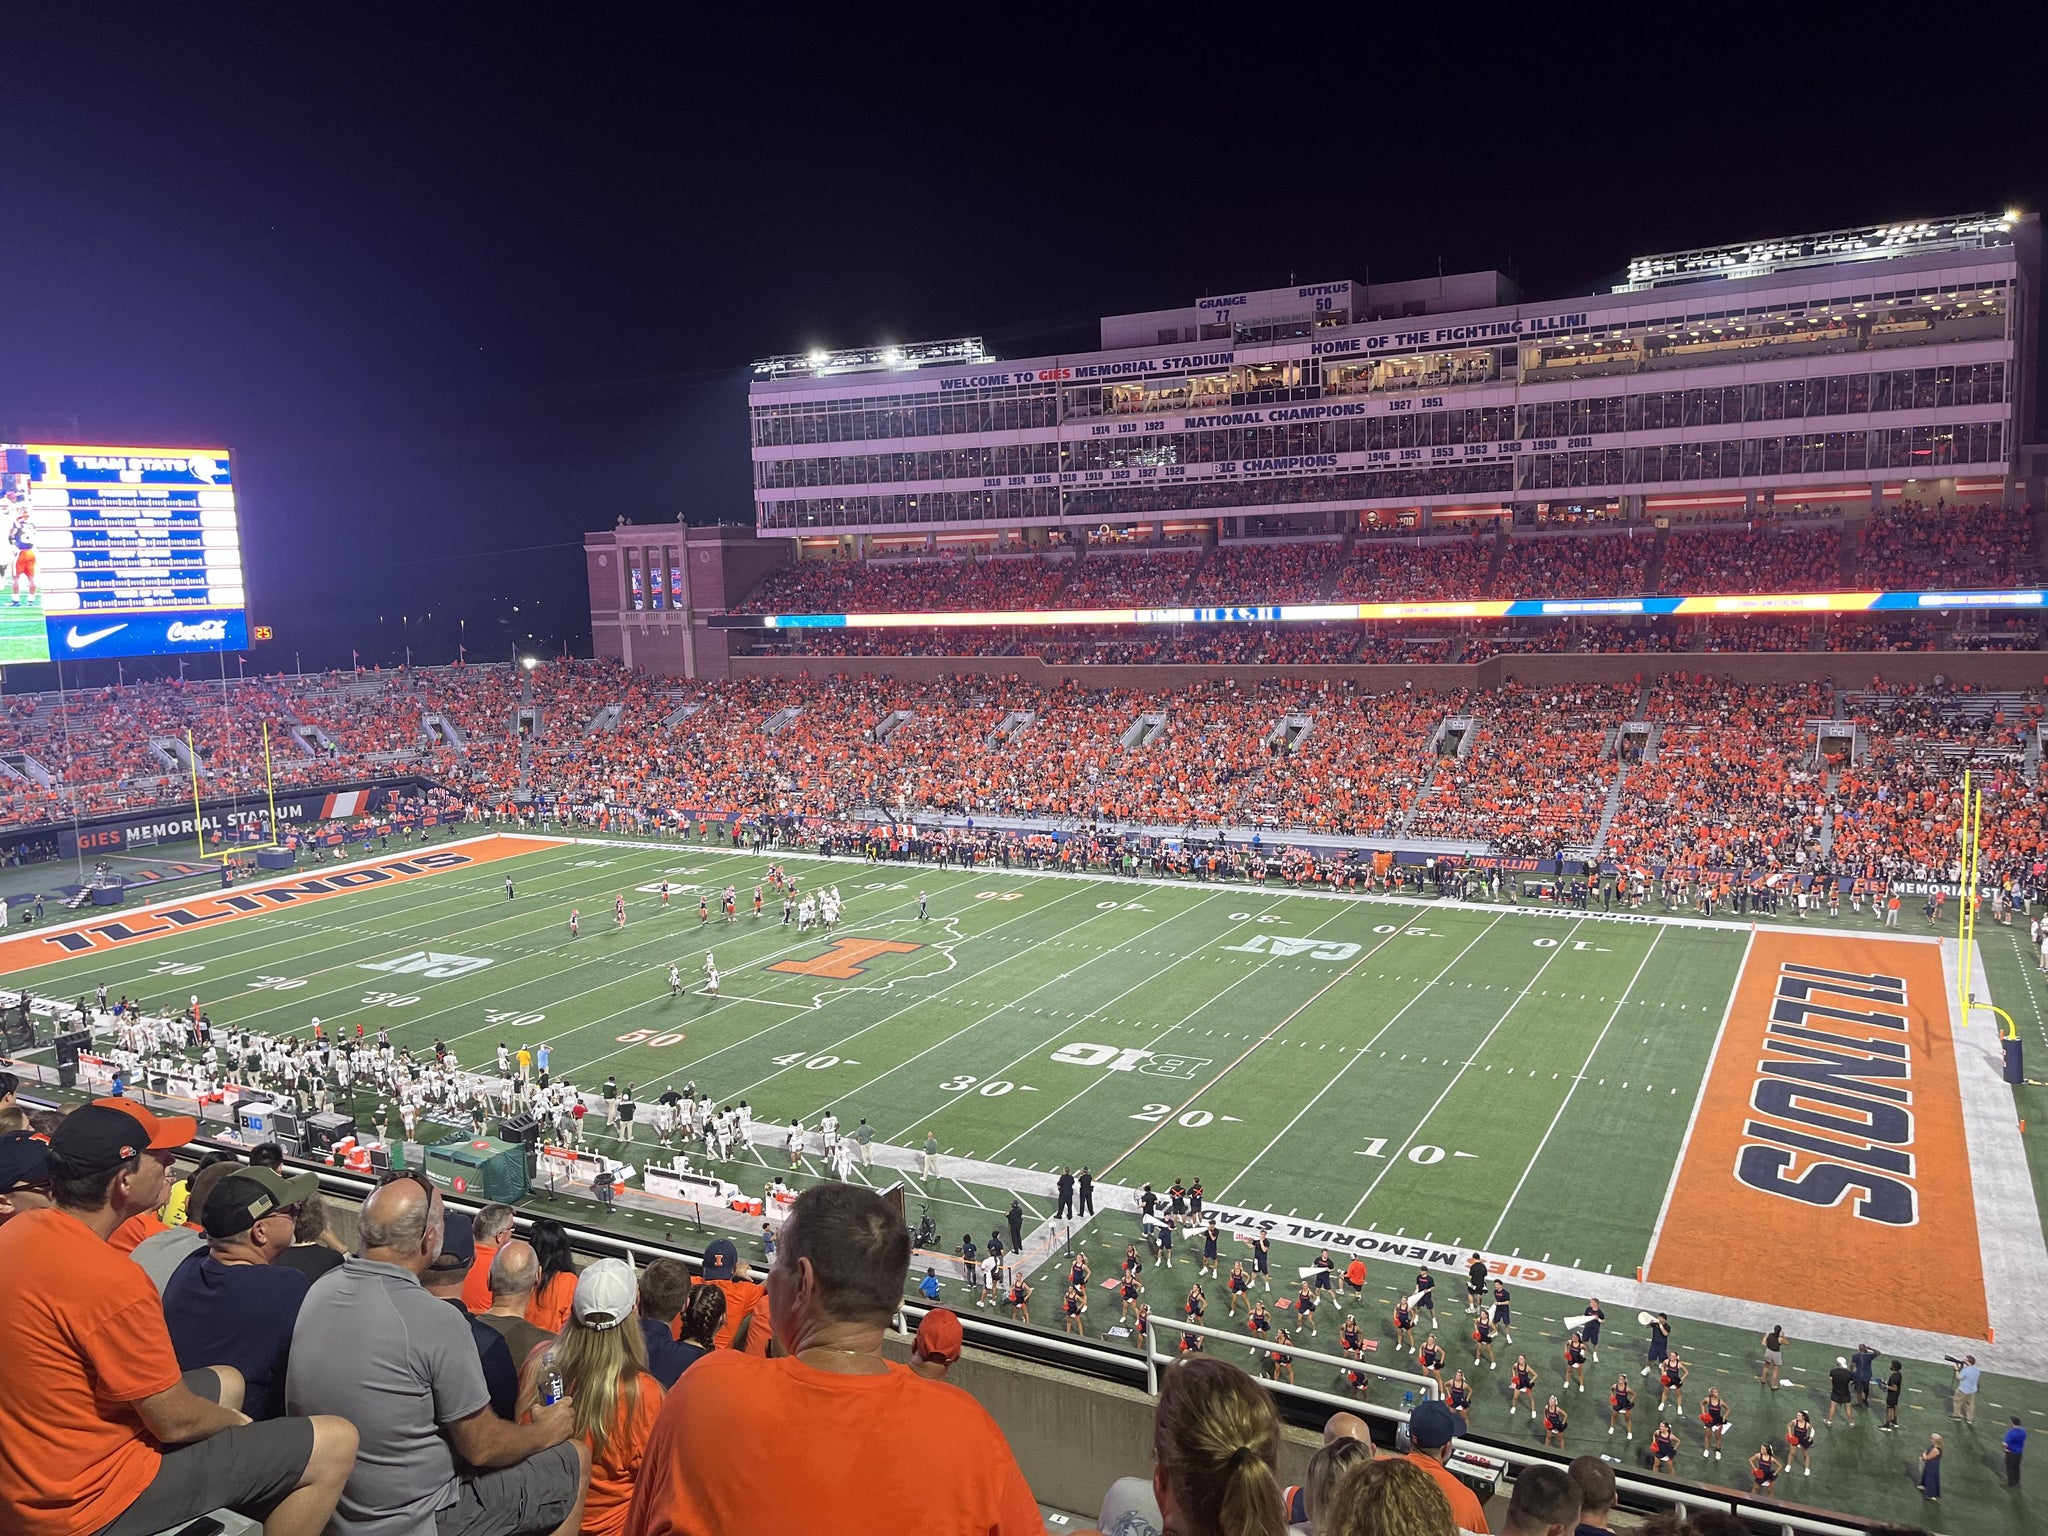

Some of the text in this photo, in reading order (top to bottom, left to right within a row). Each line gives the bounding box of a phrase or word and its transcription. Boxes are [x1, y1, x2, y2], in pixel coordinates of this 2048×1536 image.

[1298, 283, 1349, 298] BUTKUS
[1199, 296, 1247, 309] GRANGE
[1316, 298, 1332, 311] 50
[1216, 310, 1230, 322] 77
[1311, 313, 1587, 355] HOME OF THE FIGHTING ILLINI
[940, 353, 1234, 390] WELCOME TO GIES MEMORIAL STADIUM
[1091, 397, 1443, 436] 1914 1919 1923 NATIONAL CHAMPIONS 1927 1951
[73, 457, 187, 471] TEAM STATS
[1008, 476, 1026, 486] 1914
[1033, 475, 1051, 485] 1915
[1085, 471, 1104, 481] 1919
[1111, 469, 1130, 480] 1923
[1138, 467, 1157, 478] 1927
[1165, 466, 1185, 476] 1928
[1243, 454, 1337, 471] CHAMPIONS
[1367, 451, 1390, 462] 1946
[1399, 449, 1421, 460] 1951
[1431, 447, 1454, 458] 1953
[1464, 444, 1487, 455] 1963
[1497, 441, 1522, 453] 1983
[1532, 439, 1557, 451] 1990
[1568, 437, 1592, 448] 2001
[79, 804, 303, 849] GIES MEMORIAL STADUM
[1500, 858, 1539, 871] ILLINI
[864, 882, 909, 891] 40
[43, 853, 473, 953] ILLINOIS
[975, 890, 1024, 902] 50
[1095, 902, 1145, 912] 40
[1516, 907, 1571, 916] FIELD
[1227, 912, 1281, 924] 30
[1372, 925, 1432, 937] 20
[1219, 934, 1362, 962] CAT
[1532, 938, 1595, 951] 10
[762, 936, 928, 980] I
[147, 962, 206, 976] 10
[247, 975, 308, 992] 20
[361, 991, 421, 1008] 30
[484, 1010, 546, 1027] 40
[616, 1029, 687, 1048] 50
[771, 1052, 840, 1071] 40
[938, 1074, 1012, 1097] 30
[1733, 962, 1920, 1227] ILLINOIS
[1129, 1103, 1213, 1128] 20
[1354, 1137, 1445, 1165] 10
[1287, 1222, 1457, 1266] MEMORIAL
[714, 1254, 724, 1266] I
[1466, 1256, 1546, 1282] GIES
